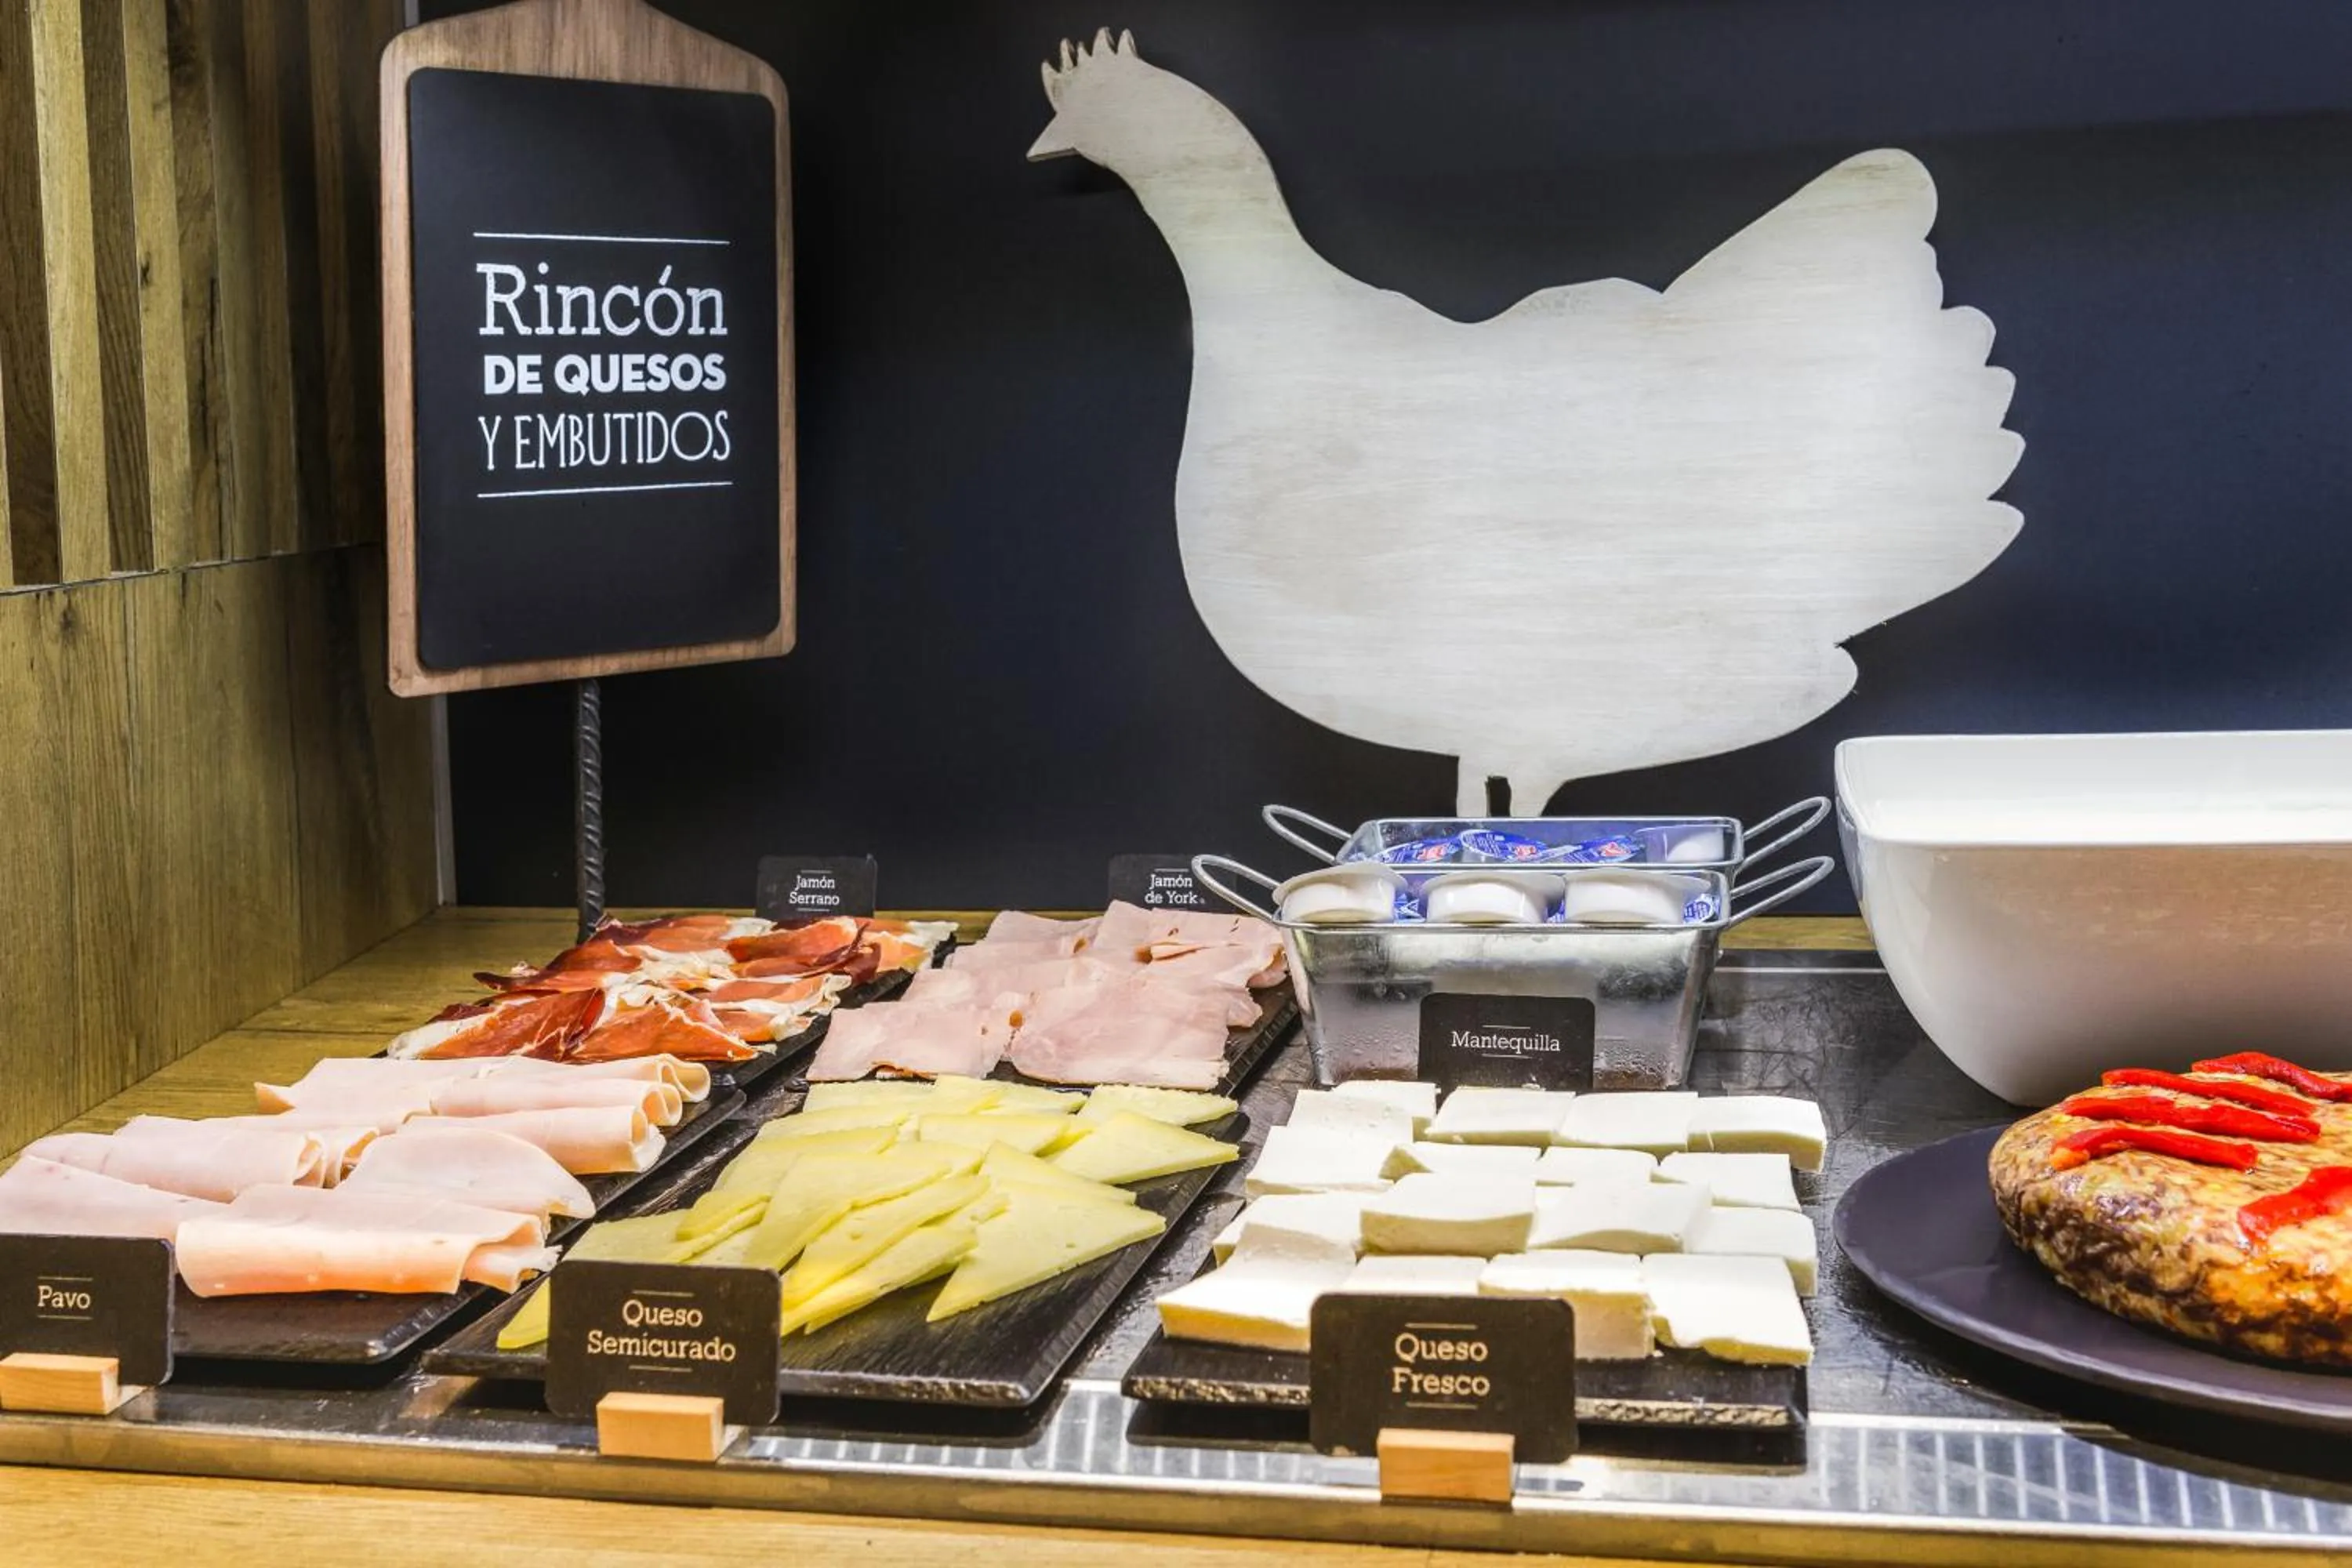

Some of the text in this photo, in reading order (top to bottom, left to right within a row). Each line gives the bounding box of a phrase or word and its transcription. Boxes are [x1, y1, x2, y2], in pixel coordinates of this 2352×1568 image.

[476, 262, 728, 337] Rincón
[483, 353, 728, 397] DE QUESOS
[477, 410, 731, 471] Y EMBUTIDOS
[794, 874, 836, 891] Jamón
[1149, 873, 1193, 890] Jamón
[788, 891, 840, 906] Serrano
[1144, 890, 1199, 904] de York
[1450, 1030, 1561, 1054] Mantequilla
[37, 1285, 93, 1309] Pavo
[622, 1299, 704, 1327] Queso
[587, 1330, 737, 1363] Semicurado
[1394, 1332, 1489, 1363] Queso
[1391, 1367, 1491, 1396] Fresco
